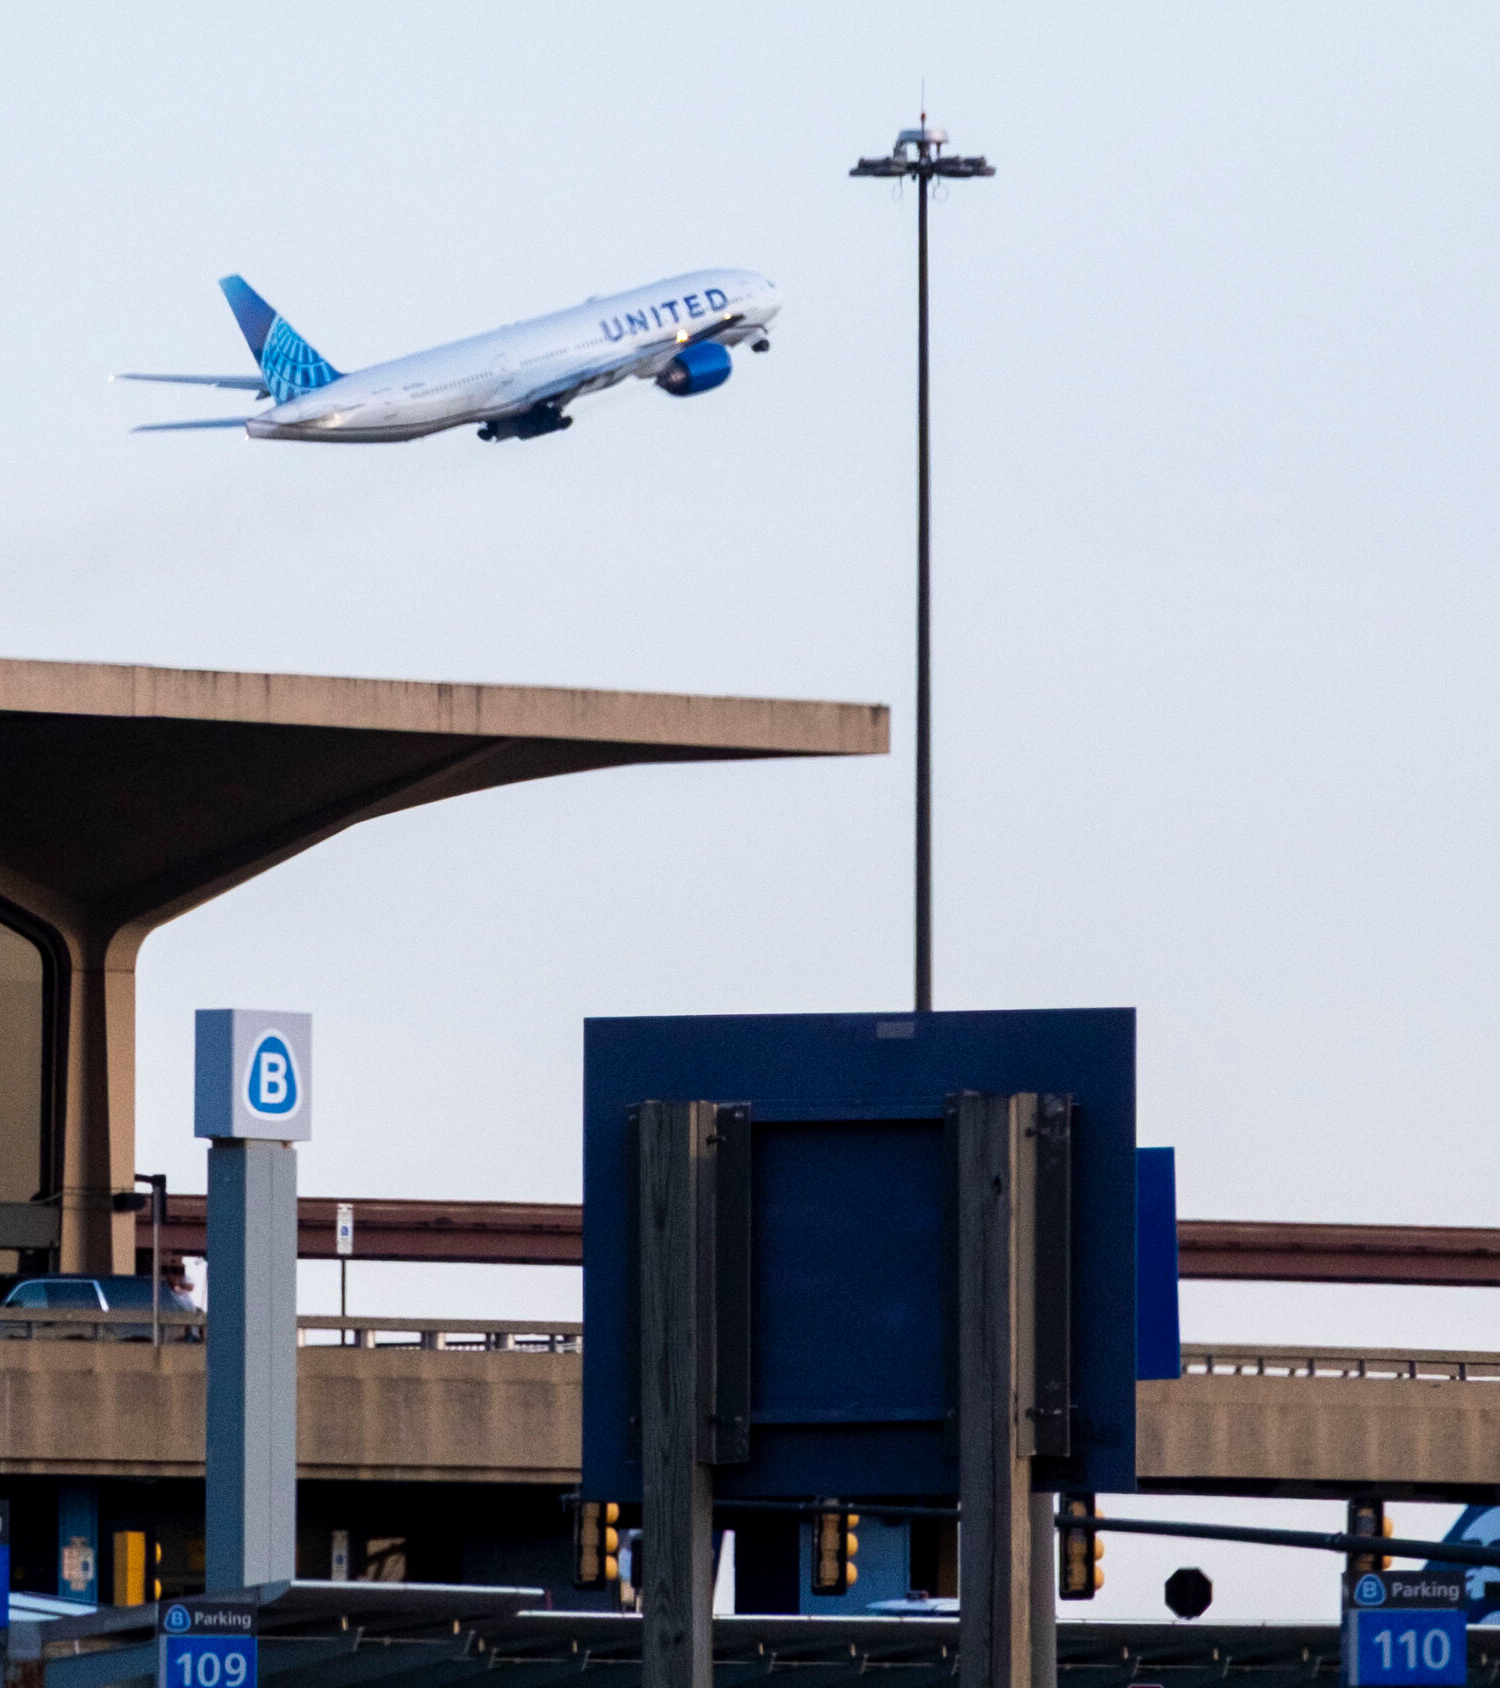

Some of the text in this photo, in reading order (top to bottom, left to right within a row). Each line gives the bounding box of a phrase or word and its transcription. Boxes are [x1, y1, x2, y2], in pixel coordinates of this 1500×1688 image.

[601, 288, 728, 341] UNITED
[259, 1051, 288, 1104] B
[1362, 1580, 1460, 1601] B Parking
[171, 1610, 252, 1629] B Parking
[1373, 1629, 1451, 1670] 110
[176, 1652, 247, 1687] 109
